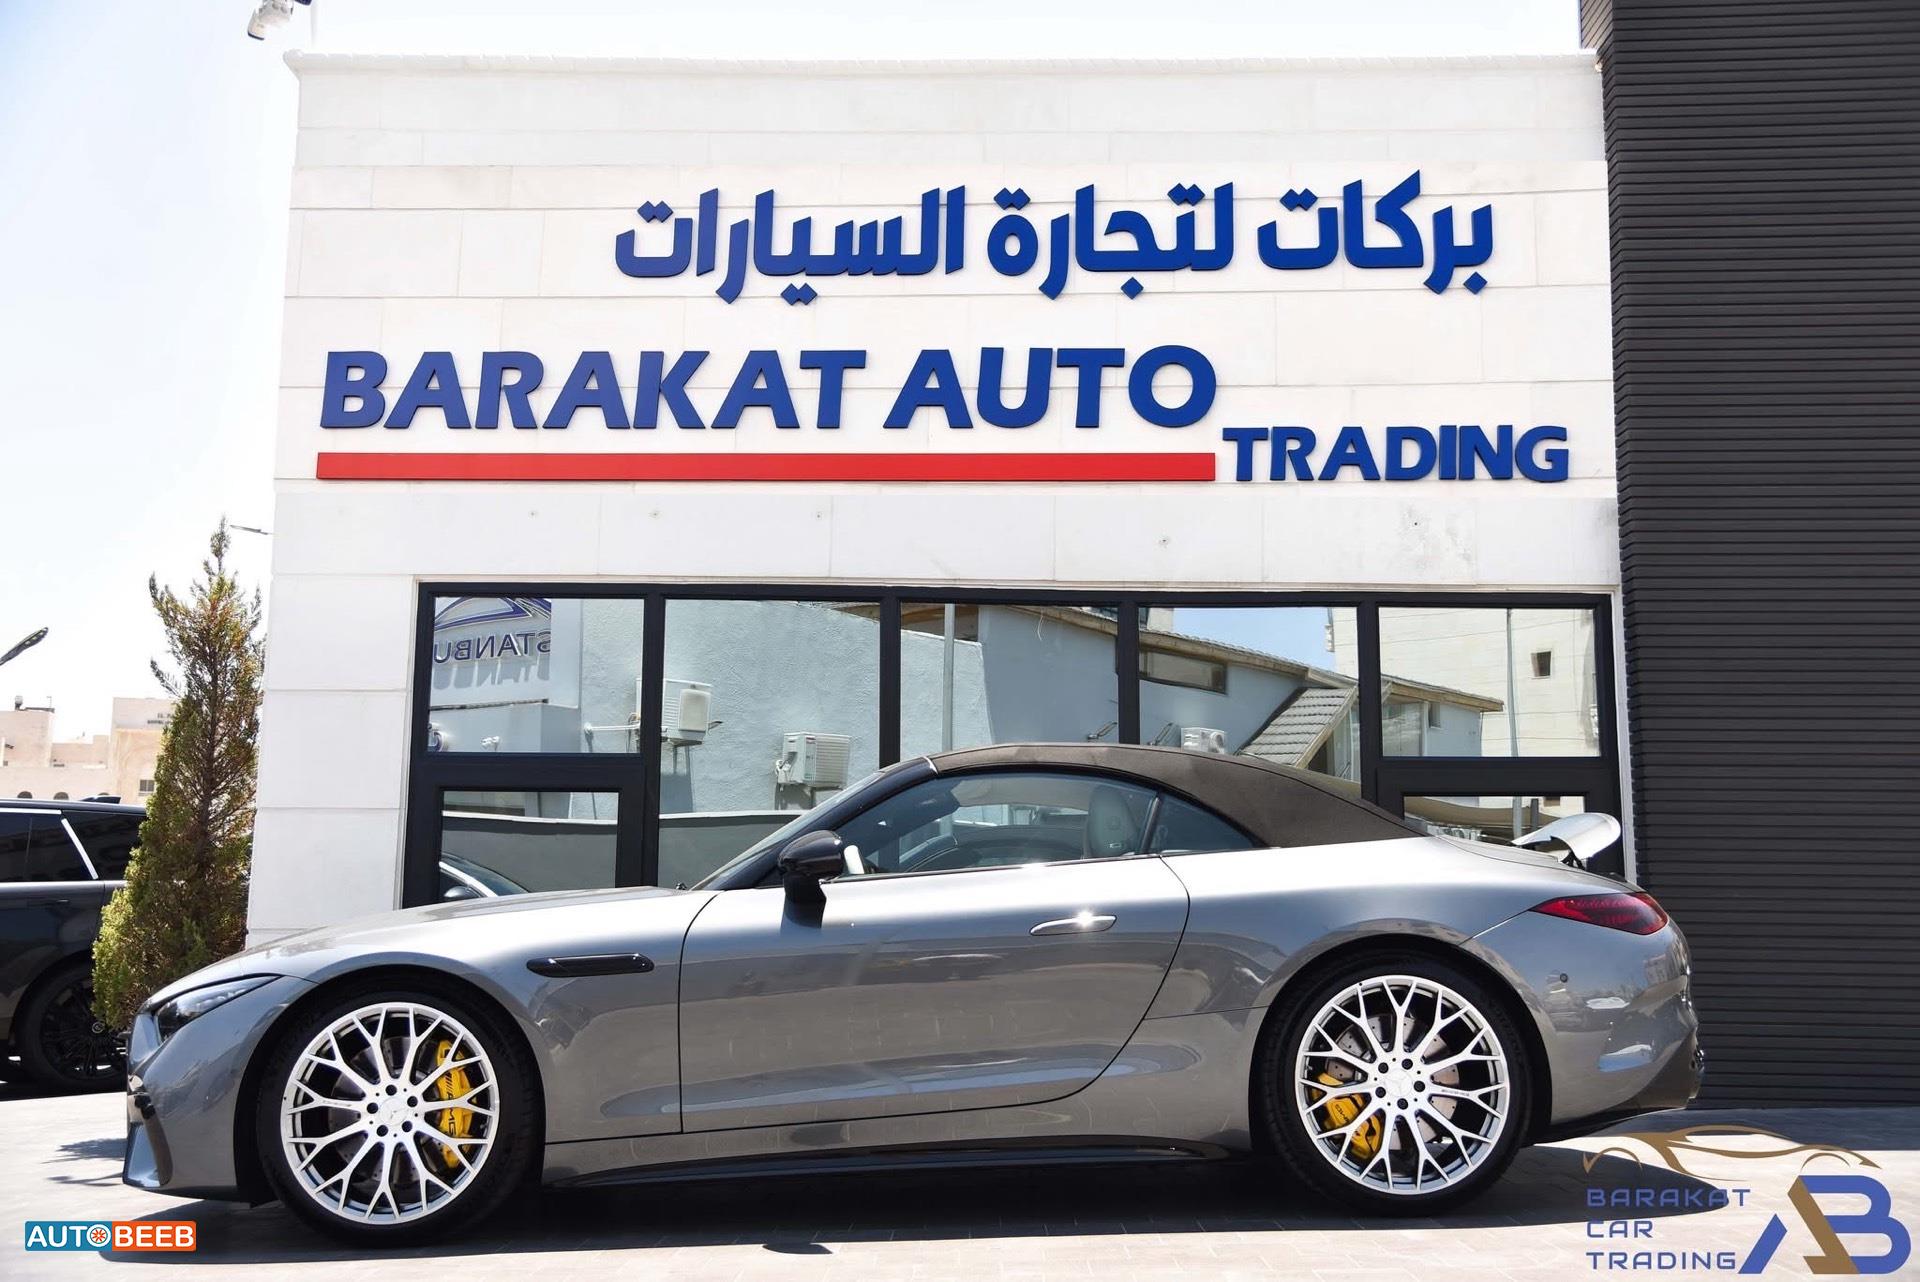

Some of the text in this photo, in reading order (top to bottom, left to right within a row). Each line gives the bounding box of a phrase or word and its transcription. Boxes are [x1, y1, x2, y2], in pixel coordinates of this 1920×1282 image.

[615, 169, 1494, 305] بركات لتجارة السيارات
[320, 345, 1217, 429] BARAKAT AUTO
[1222, 425, 1570, 482] TRADING
